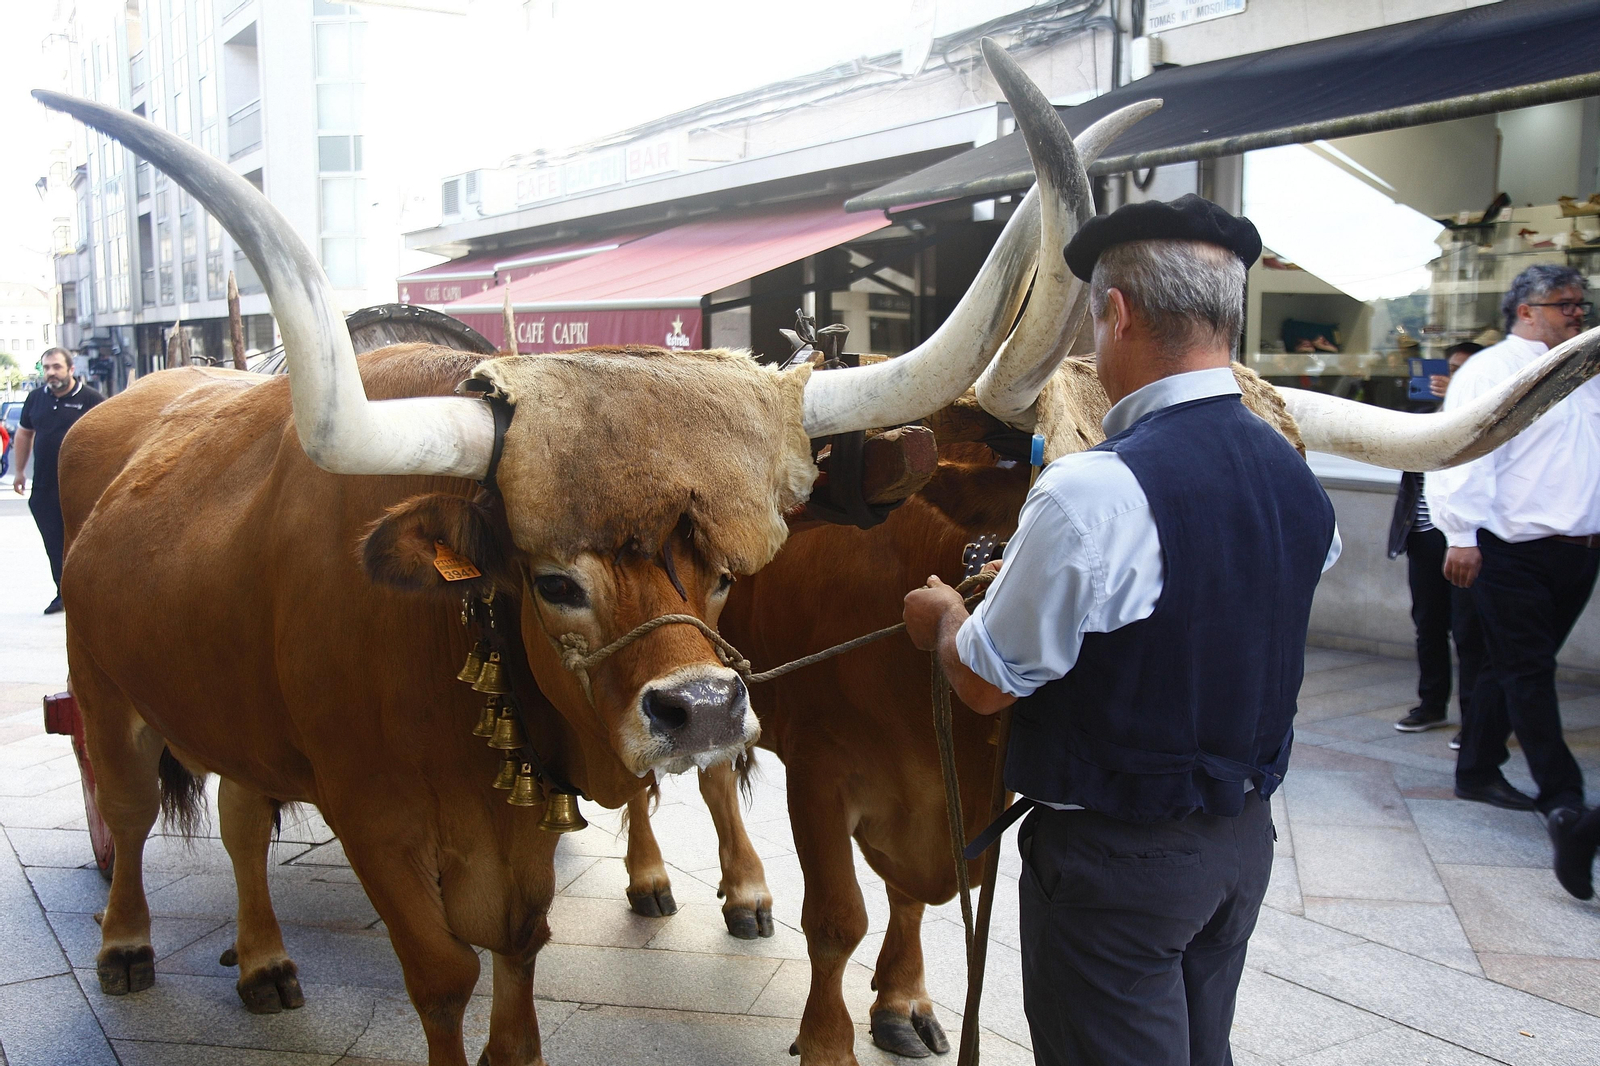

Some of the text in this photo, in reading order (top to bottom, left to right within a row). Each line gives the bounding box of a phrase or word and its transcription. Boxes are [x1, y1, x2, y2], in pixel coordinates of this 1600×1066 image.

[566, 154, 619, 189] CAPRI
[629, 141, 672, 175] BAR
[442, 286, 462, 301] CAPRI
[517, 317, 589, 345] CAFÉ CAPRI
[665, 332, 690, 347] Estrella
[444, 567, 477, 580] 3941
